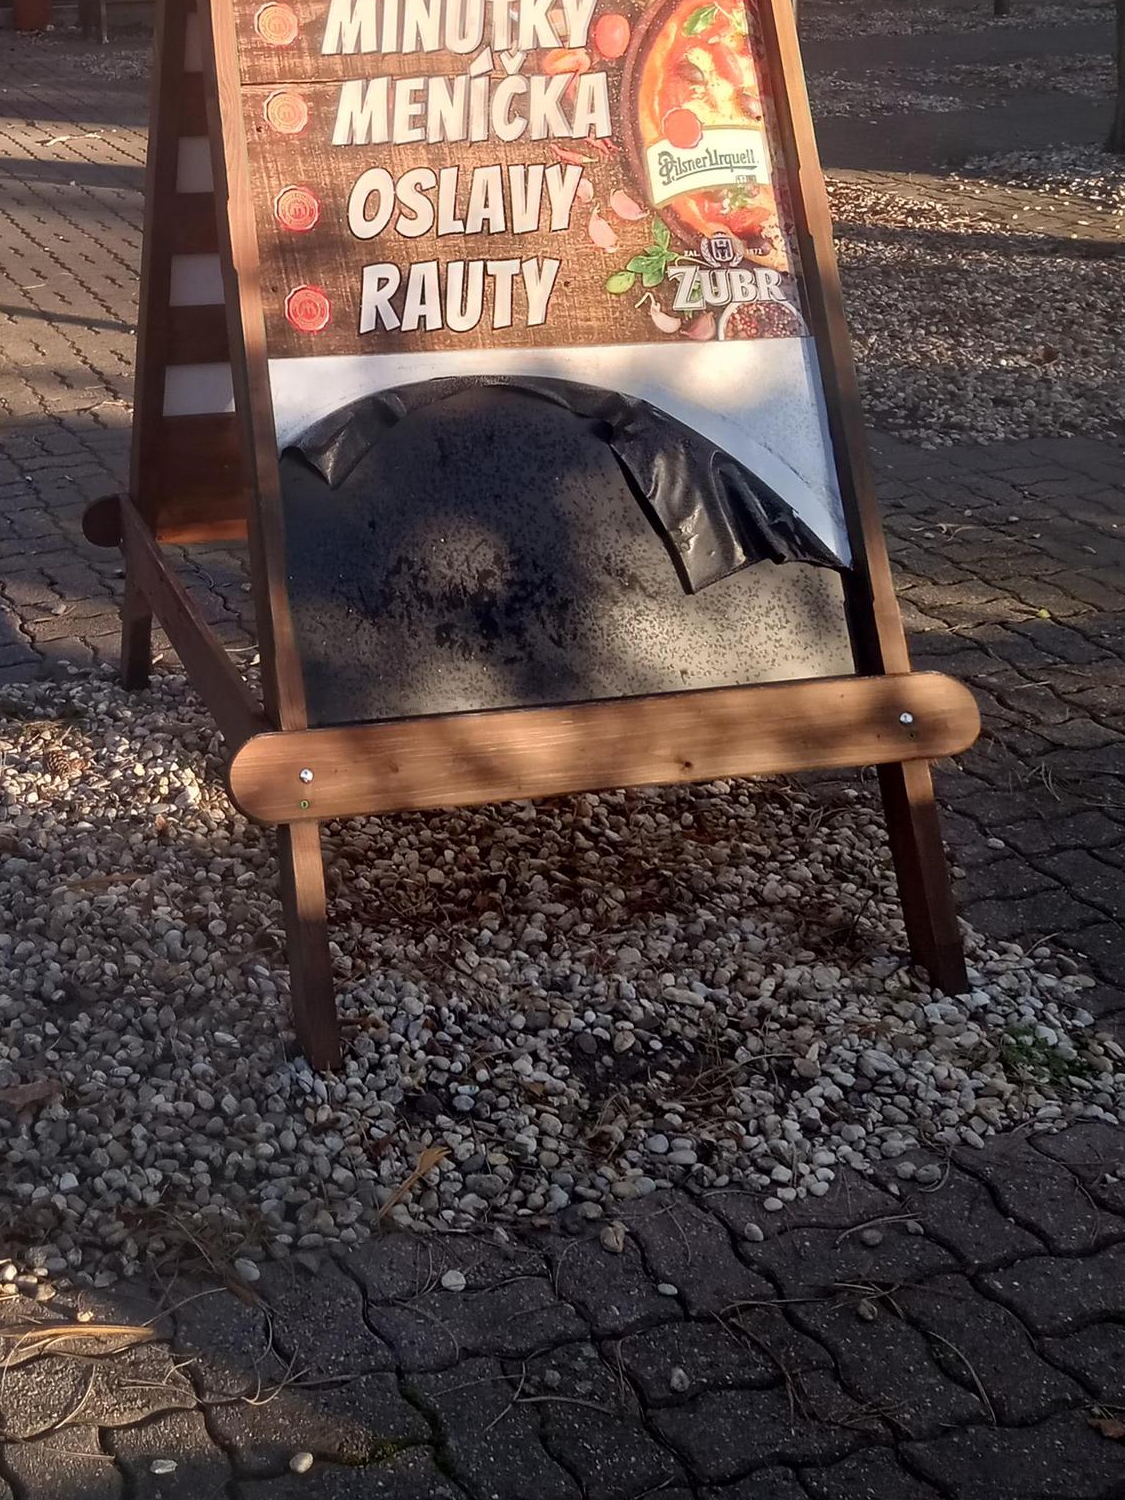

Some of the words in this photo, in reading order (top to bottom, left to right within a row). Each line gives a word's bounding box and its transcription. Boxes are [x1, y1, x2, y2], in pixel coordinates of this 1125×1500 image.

[331, 46, 613, 148] MENÍČKA
[347, 163, 585, 242] OSLAVY
[658, 149, 708, 186] Pilsner
[706, 147, 756, 173] Urquell
[358, 257, 562, 337] RAUTY
[666, 265, 787, 311] ZUBR
